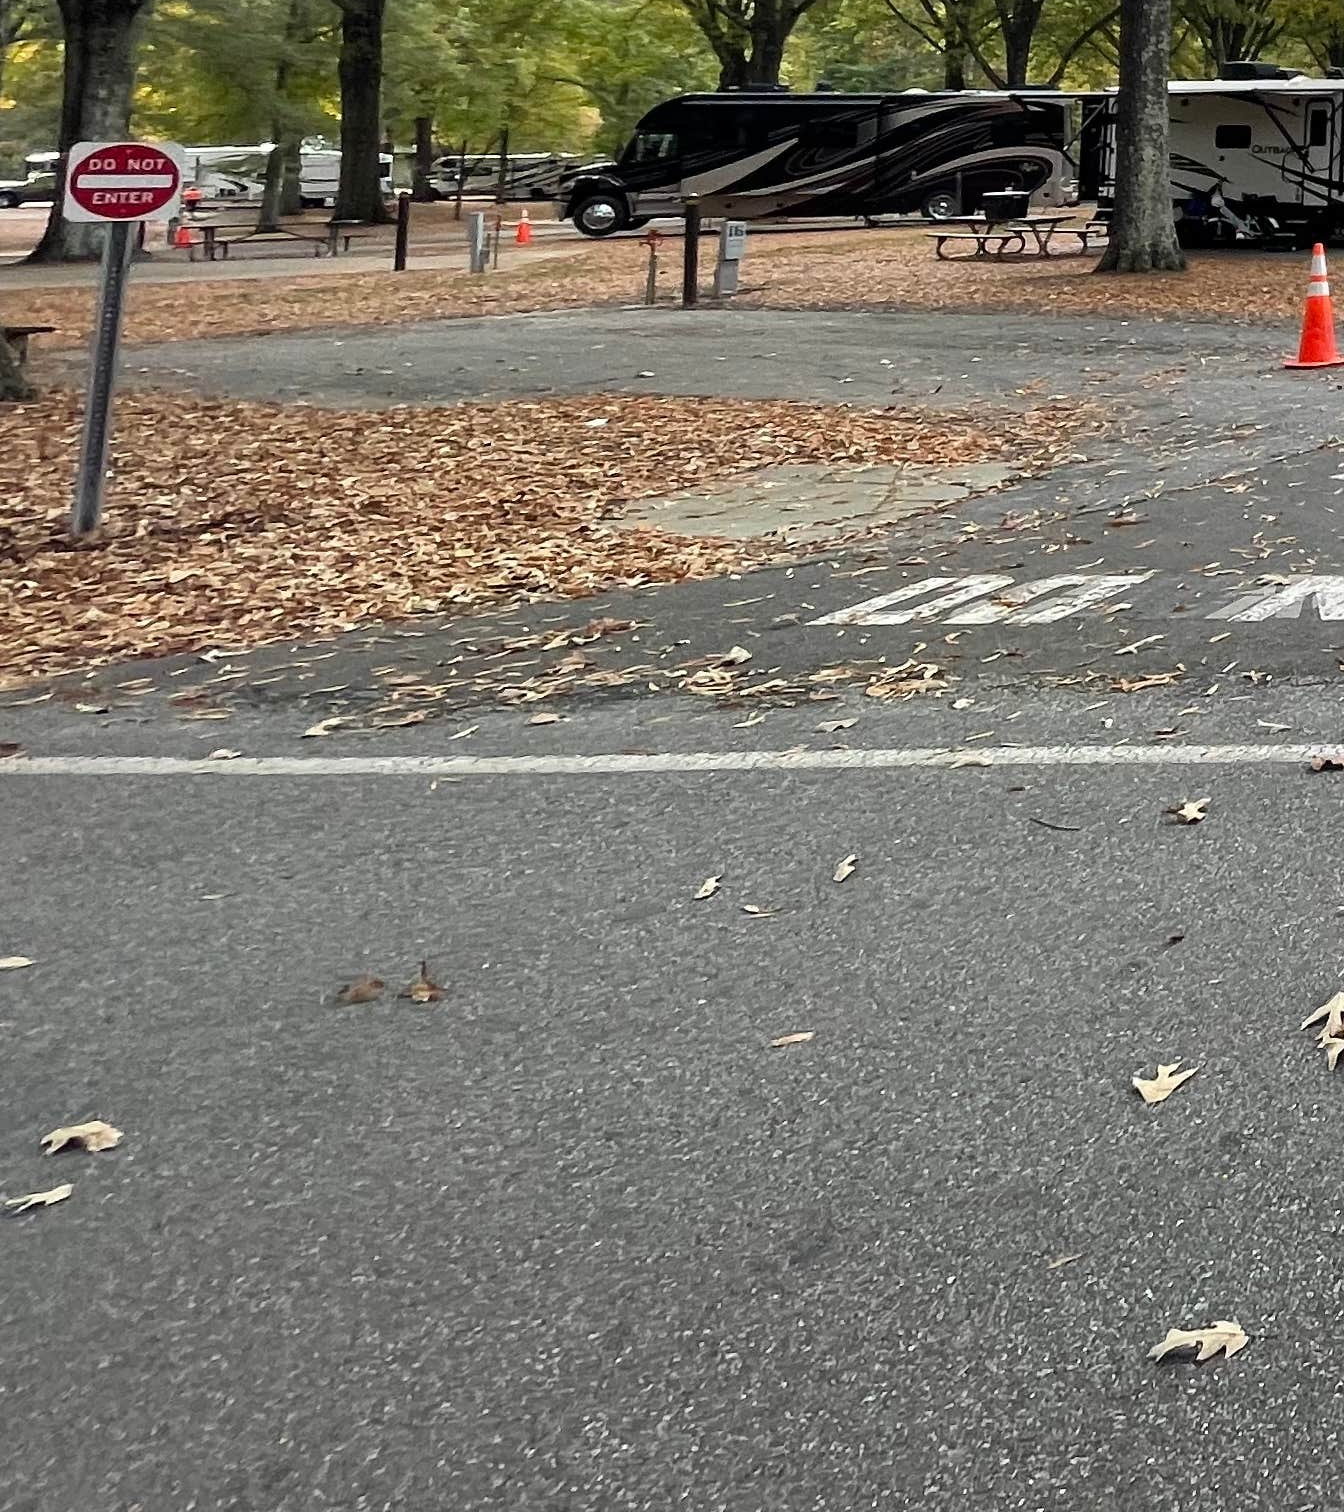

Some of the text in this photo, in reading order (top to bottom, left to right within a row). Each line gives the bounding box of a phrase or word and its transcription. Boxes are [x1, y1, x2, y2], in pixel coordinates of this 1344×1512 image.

[88, 158, 166, 171] DO NOT
[91, 191, 155, 205] ENTER
[804, 570, 1155, 626] DO
